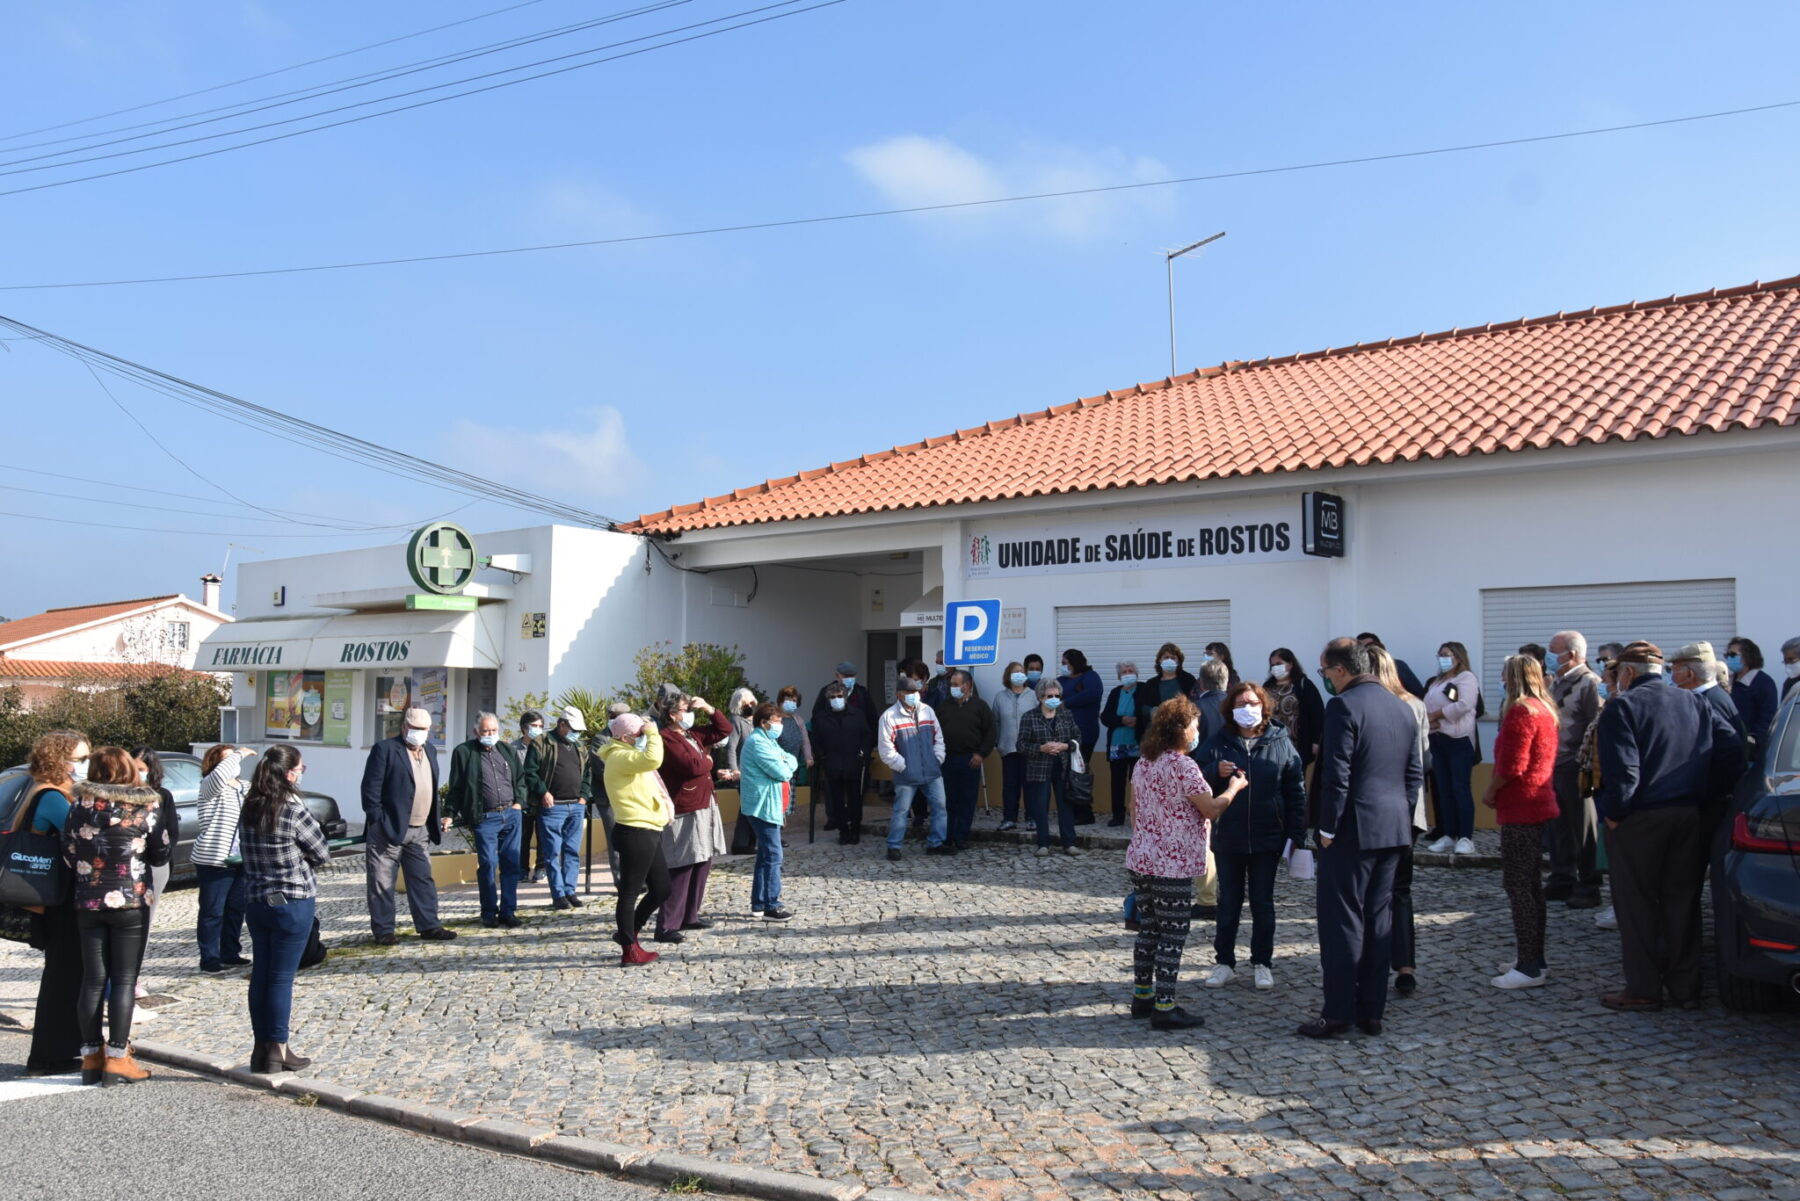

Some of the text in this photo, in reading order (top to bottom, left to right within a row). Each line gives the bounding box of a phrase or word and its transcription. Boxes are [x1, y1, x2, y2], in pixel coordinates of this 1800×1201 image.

[1321, 510, 1338, 530] MB
[998, 522, 1290, 569] UNIDADE DE SAÚDE DE ROSTOS
[954, 606, 988, 660] P
[211, 642, 283, 666] FARMÁCIA
[340, 640, 412, 663] ROSTOS
[10, 852, 52, 864] GlucoMen
